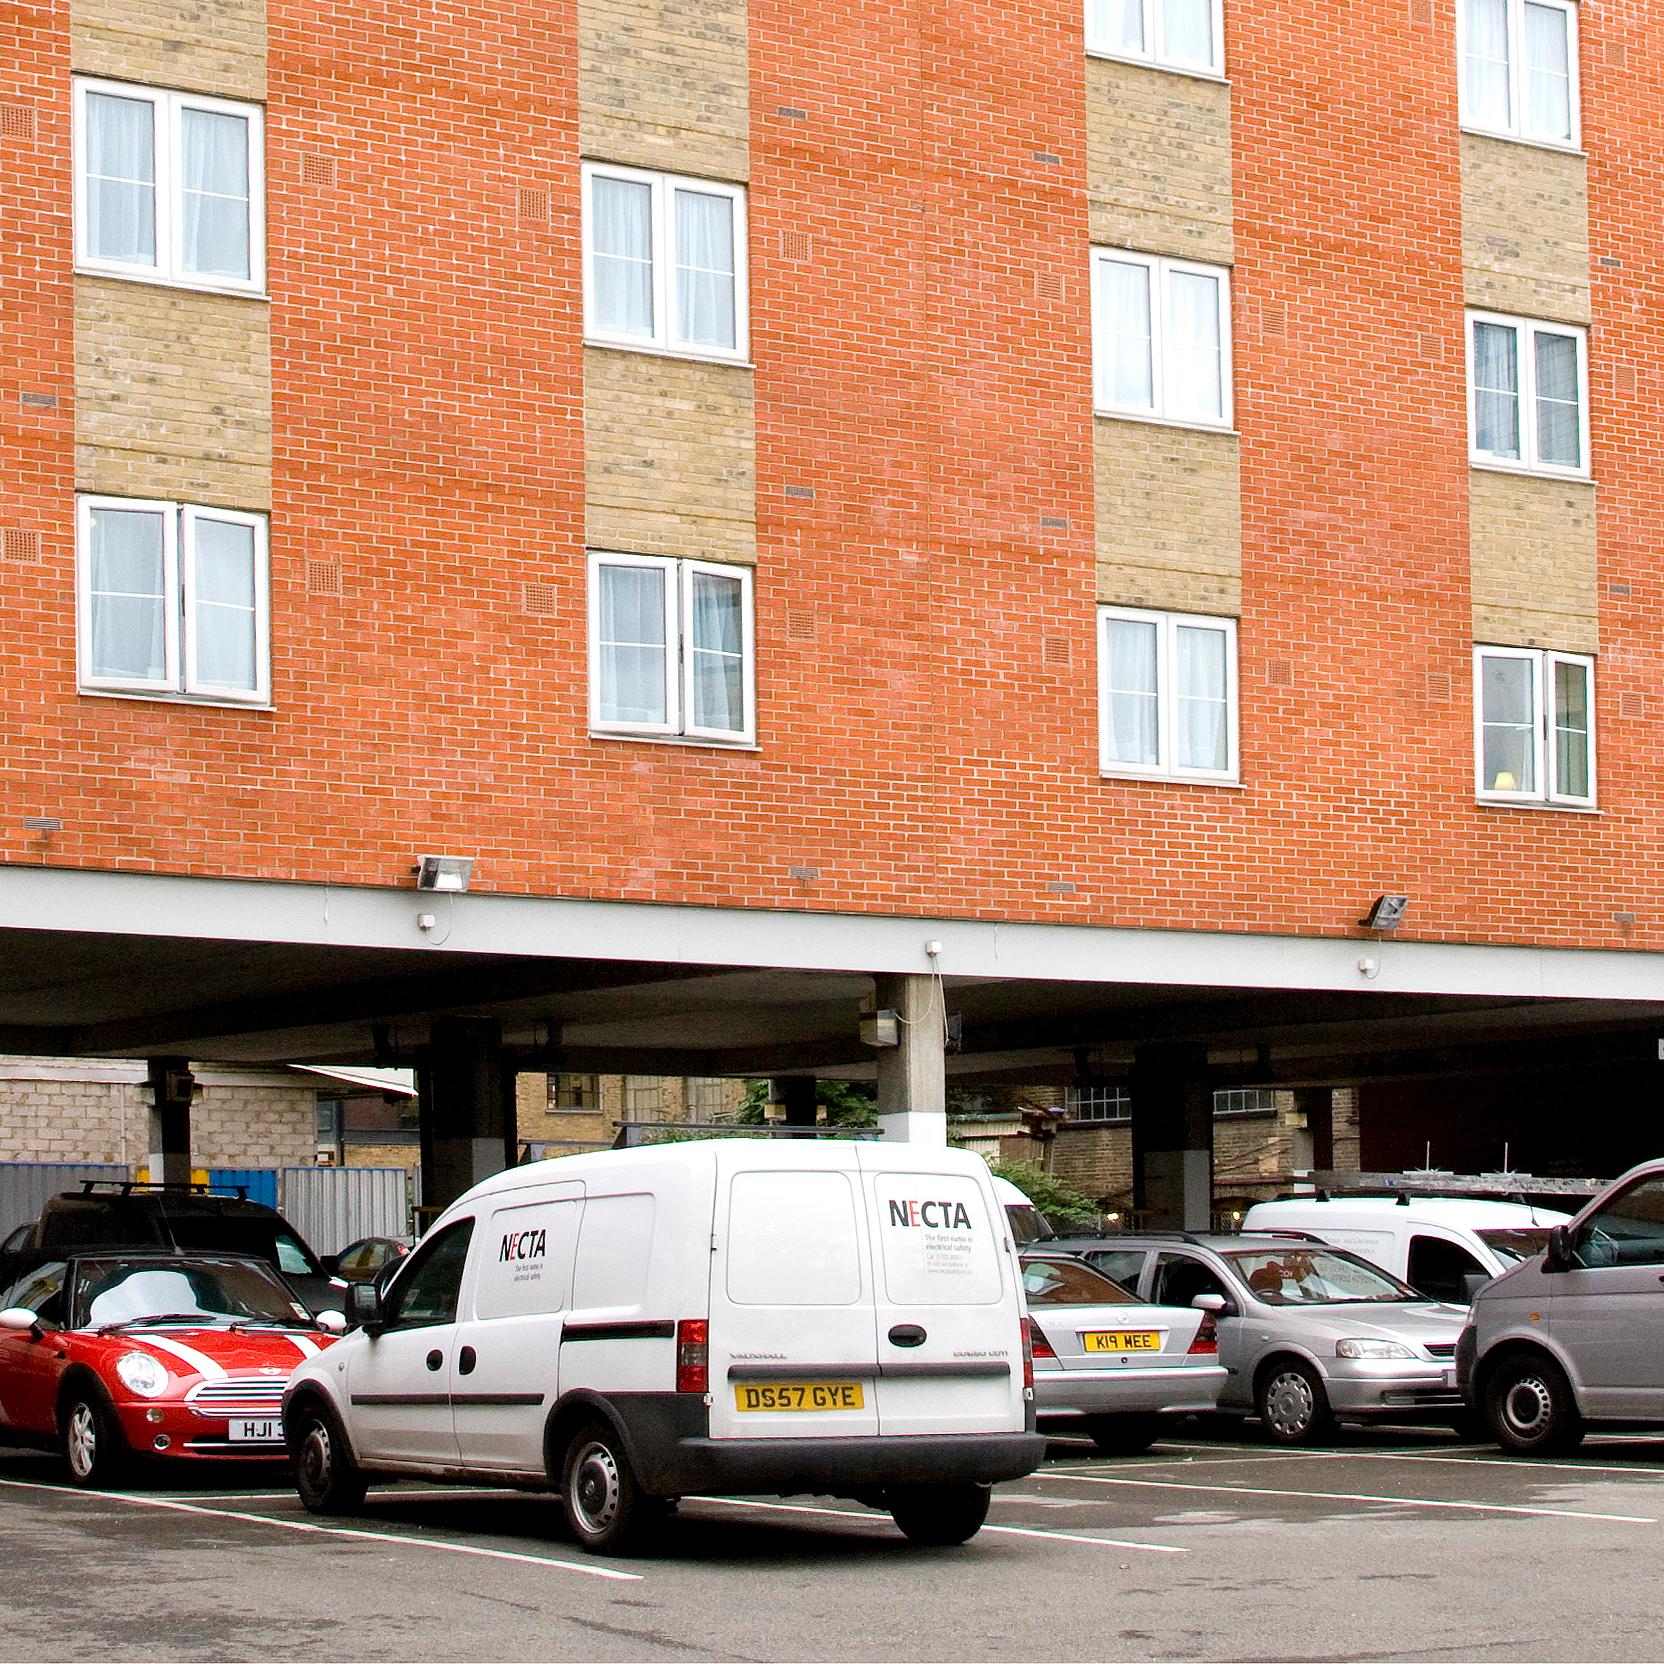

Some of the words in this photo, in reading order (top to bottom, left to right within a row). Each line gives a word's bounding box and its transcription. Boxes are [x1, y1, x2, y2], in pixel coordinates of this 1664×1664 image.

[888, 1199, 972, 1229] NECTA
[499, 1228, 547, 1263] NECTA
[1096, 1335, 1118, 1349] K19
[746, 1387, 806, 1408] DS57
[812, 1386, 856, 1407] GYE
